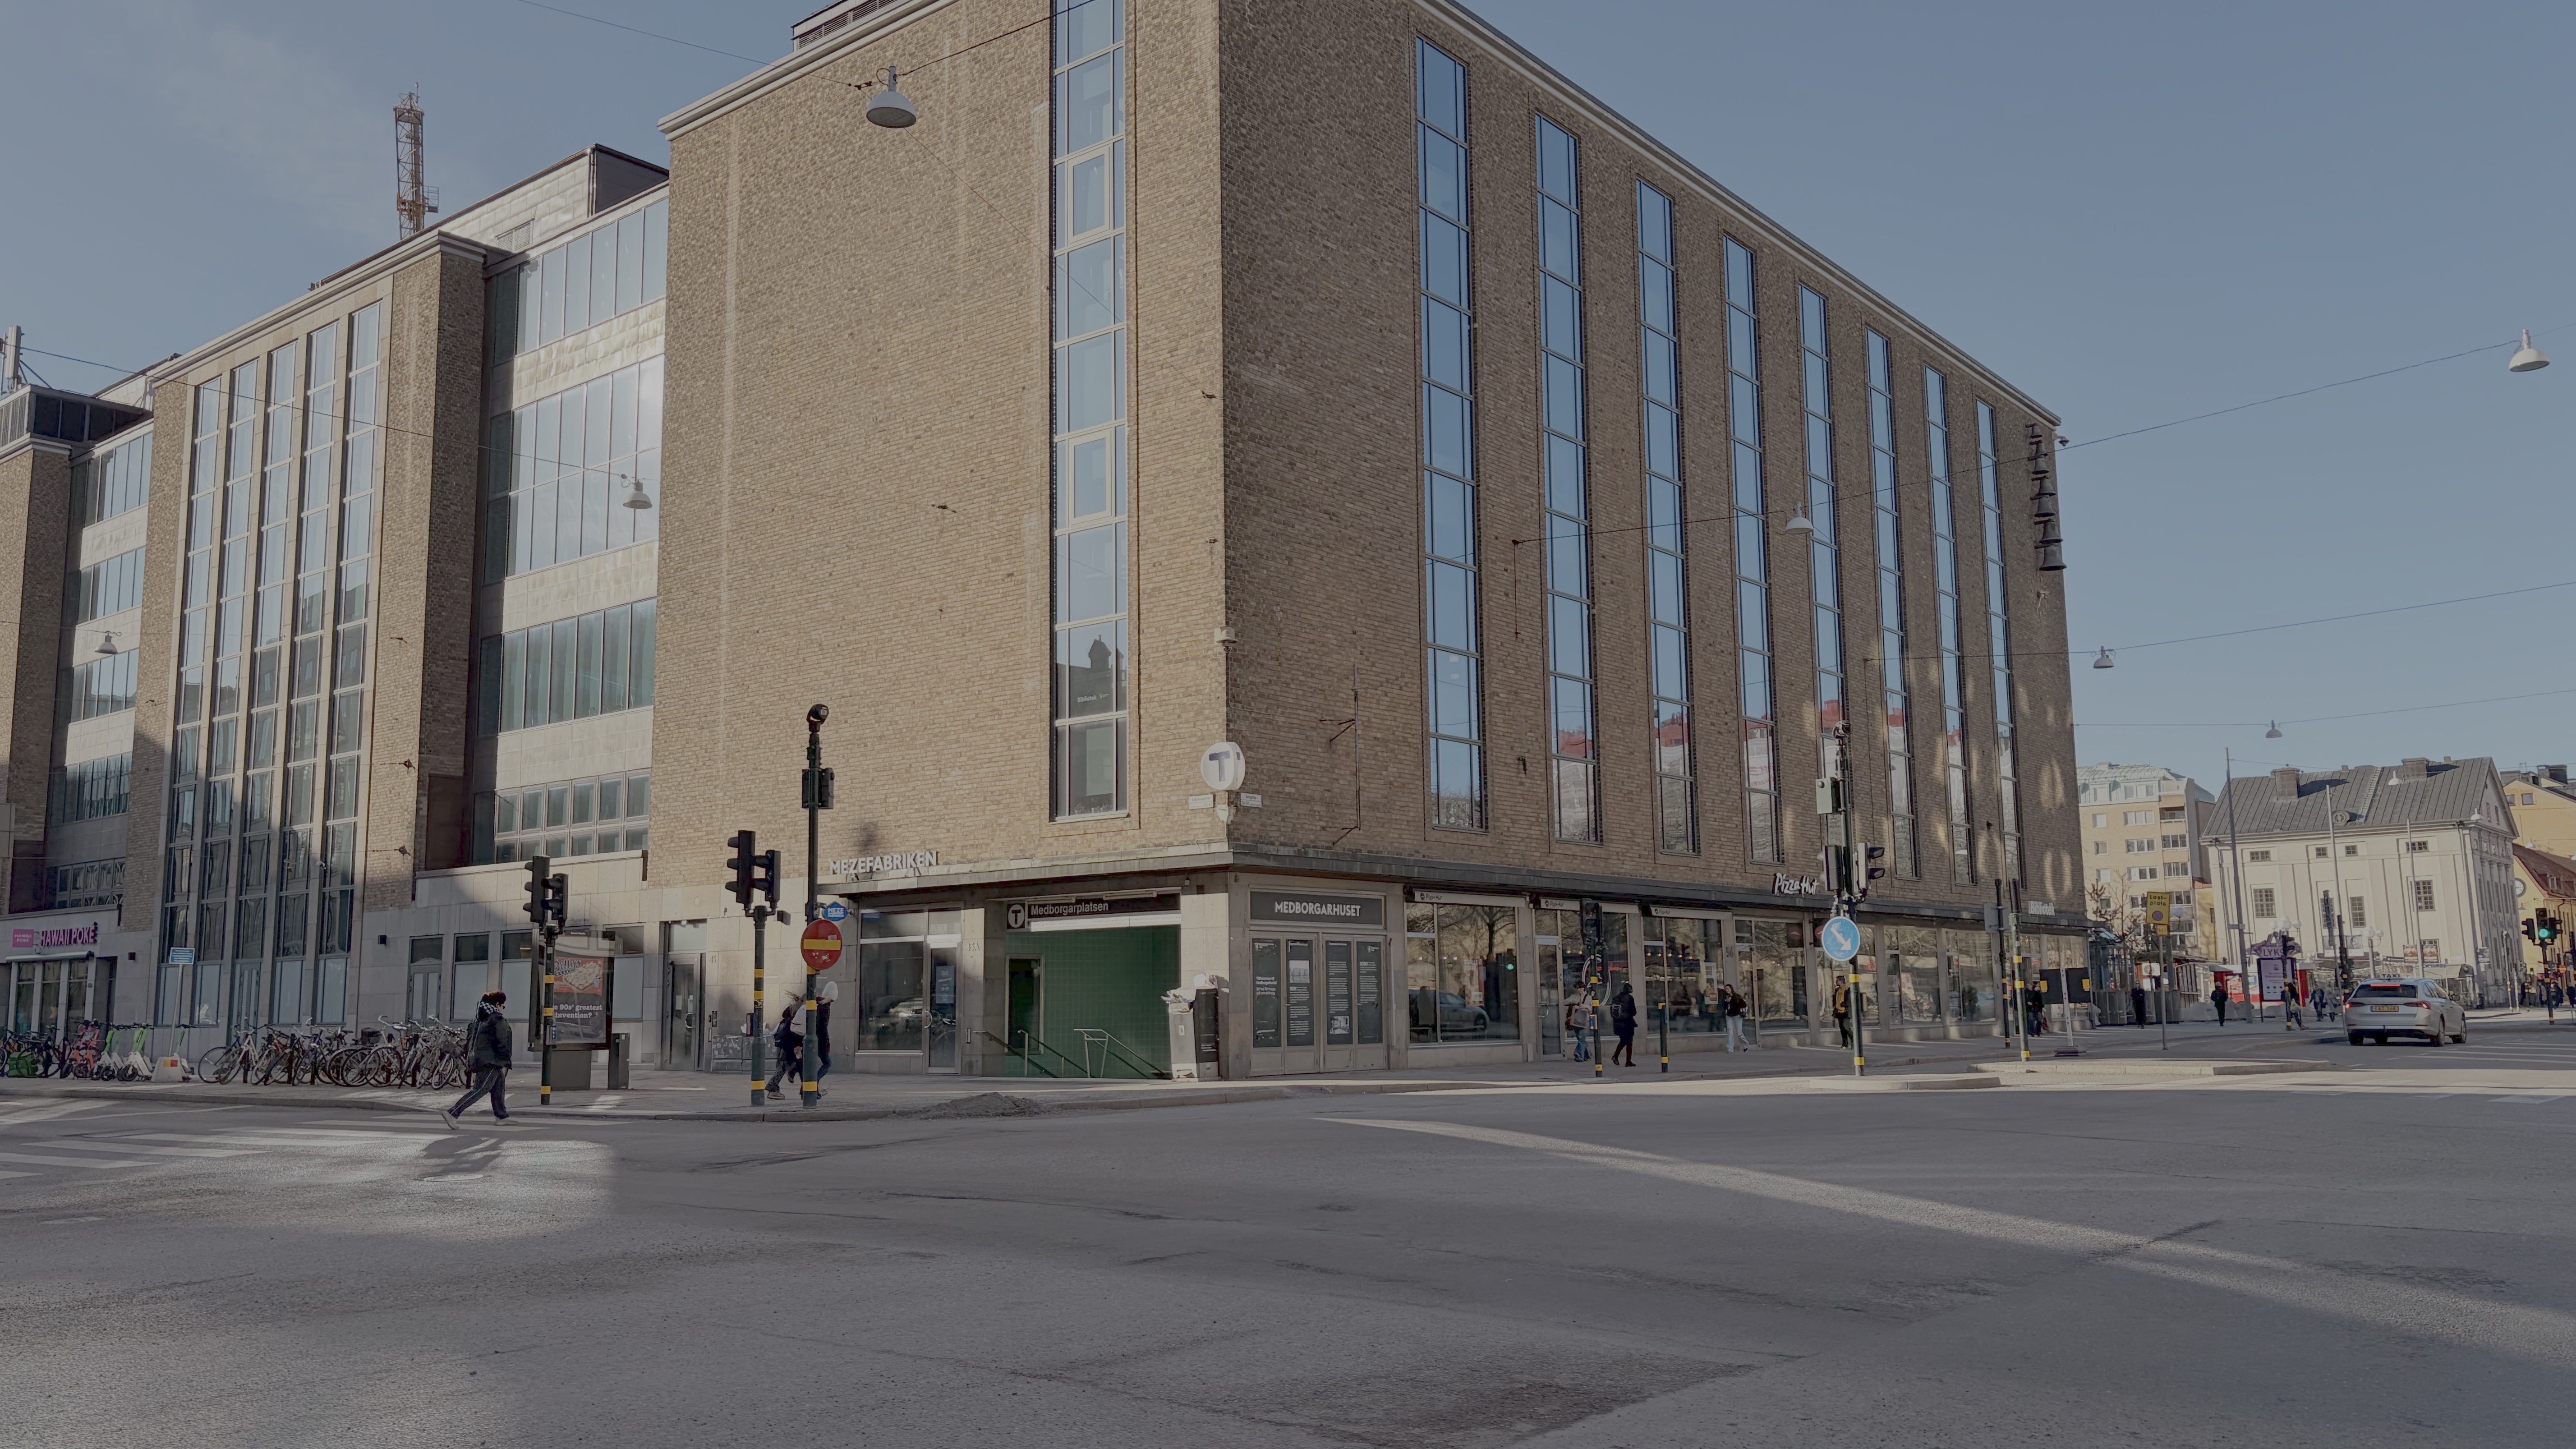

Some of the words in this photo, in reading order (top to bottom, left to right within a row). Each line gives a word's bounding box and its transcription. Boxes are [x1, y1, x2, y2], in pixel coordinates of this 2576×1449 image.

[1077, 695, 1097, 703] Bibliotek
[1209, 750, 1230, 782] T
[830, 851, 937, 876] MEZEFABRIKEN
[1775, 872, 1800, 895] Pizza
[1800, 875, 1819, 895] Hut
[1012, 909, 1021, 925] T
[1031, 902, 1109, 916] Medborgarplatsen
[1275, 901, 1361, 917] MEDBORGARHUSET
[2029, 901, 2055, 916] Bibliotek
[41, 929, 69, 947] HAWAII
